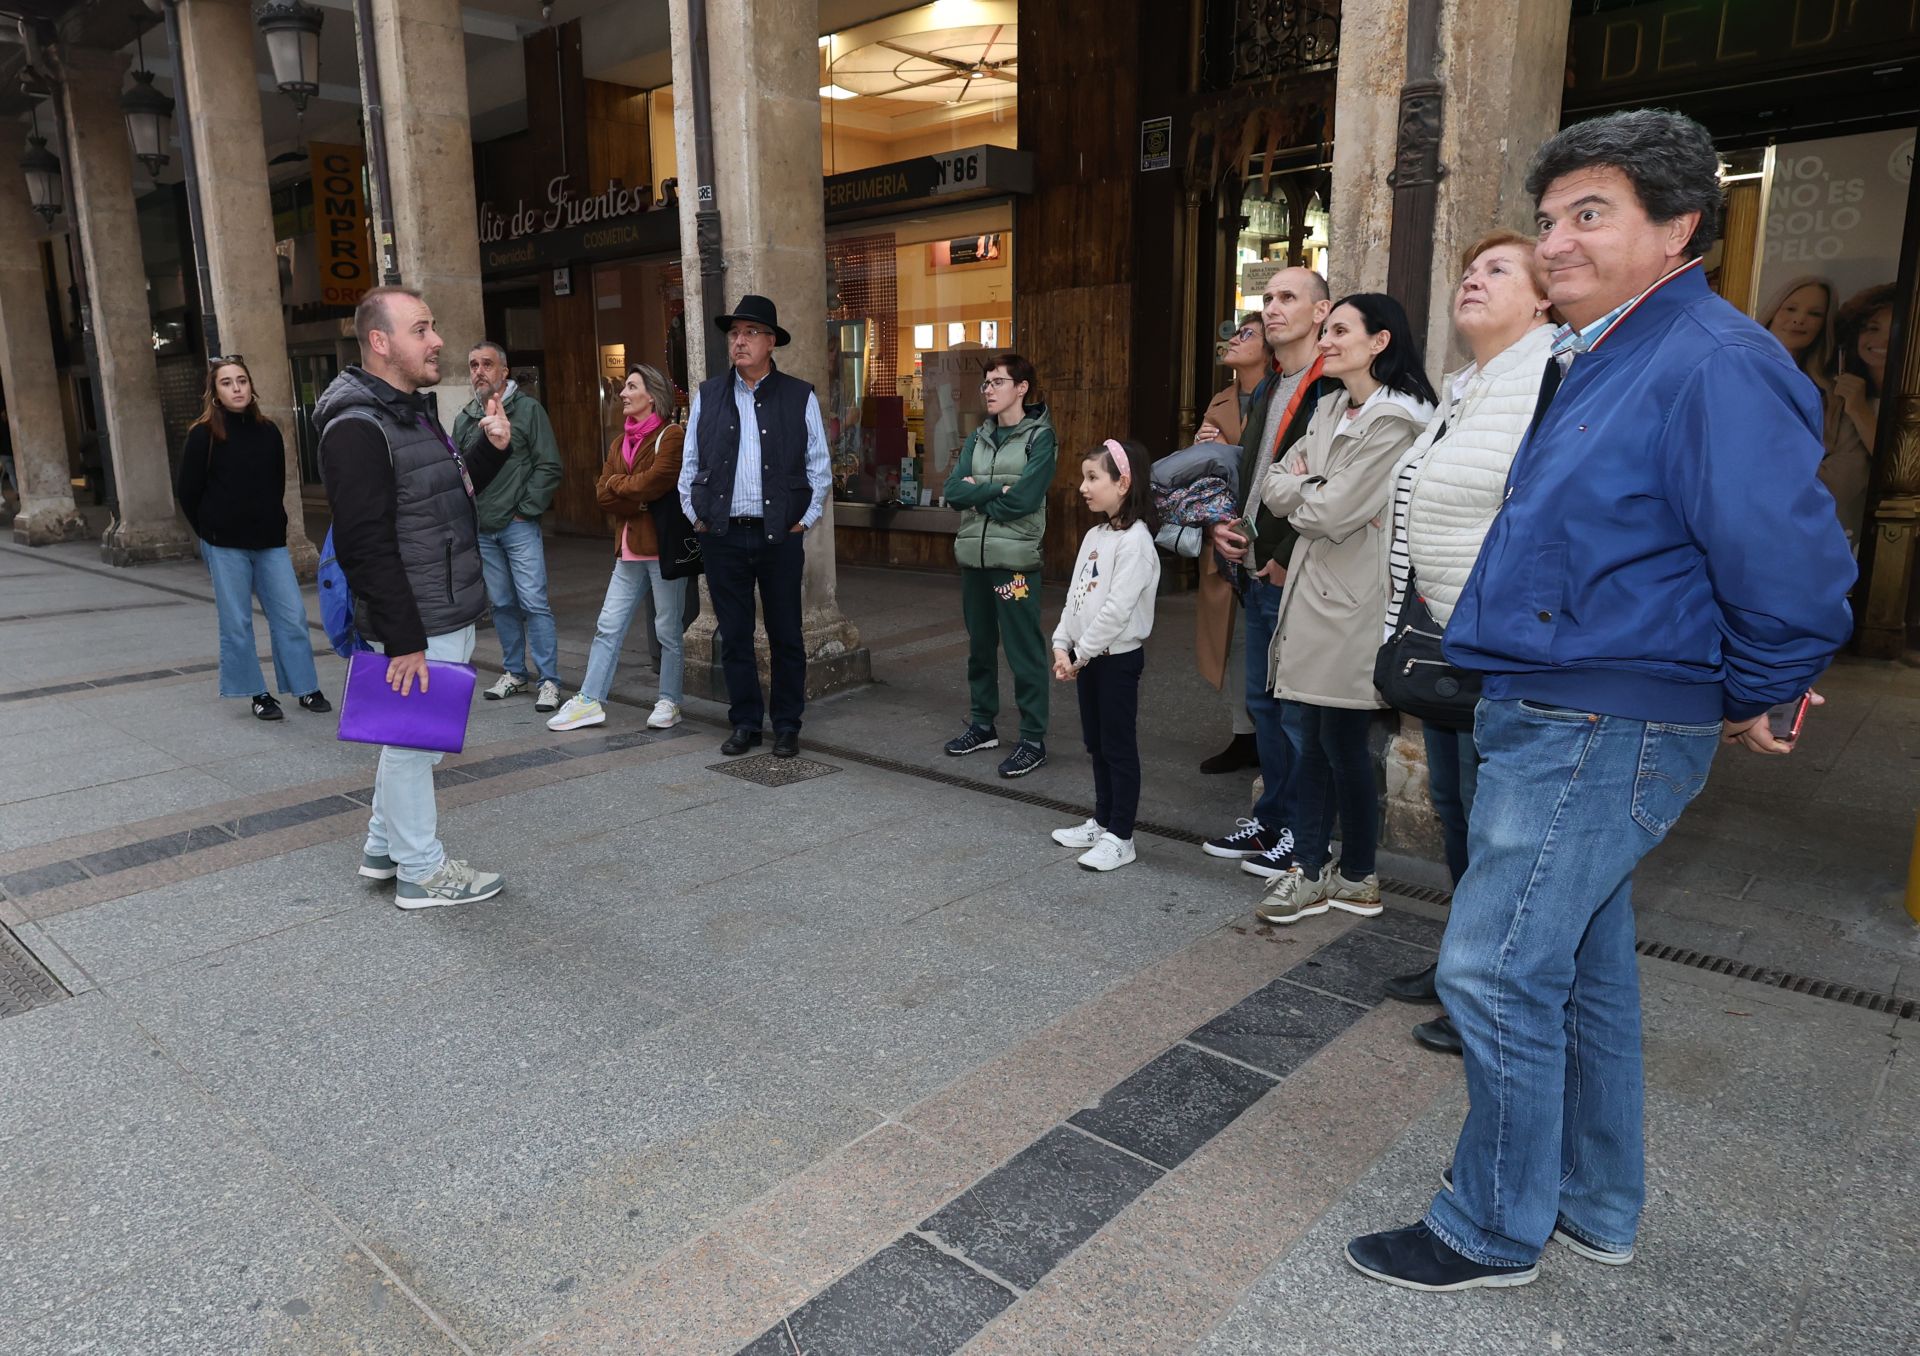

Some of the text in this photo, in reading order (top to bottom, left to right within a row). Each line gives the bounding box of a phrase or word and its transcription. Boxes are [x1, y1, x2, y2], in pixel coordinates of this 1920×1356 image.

[1602, 0, 1758, 81] DEL
[1773, 156, 1829, 182] NO,
[824, 172, 909, 208] PERFUMERIA
[1770, 178, 1865, 209] NO ES
[324, 155, 360, 280] COMPRO
[479, 202, 504, 243] lio
[511, 200, 535, 236] de
[544, 174, 643, 229] Fuentes
[1766, 207, 1861, 236] SOLO
[584, 225, 640, 249] COSMETICA
[1764, 237, 1843, 264] PELO
[940, 356, 990, 373] JUVEN
